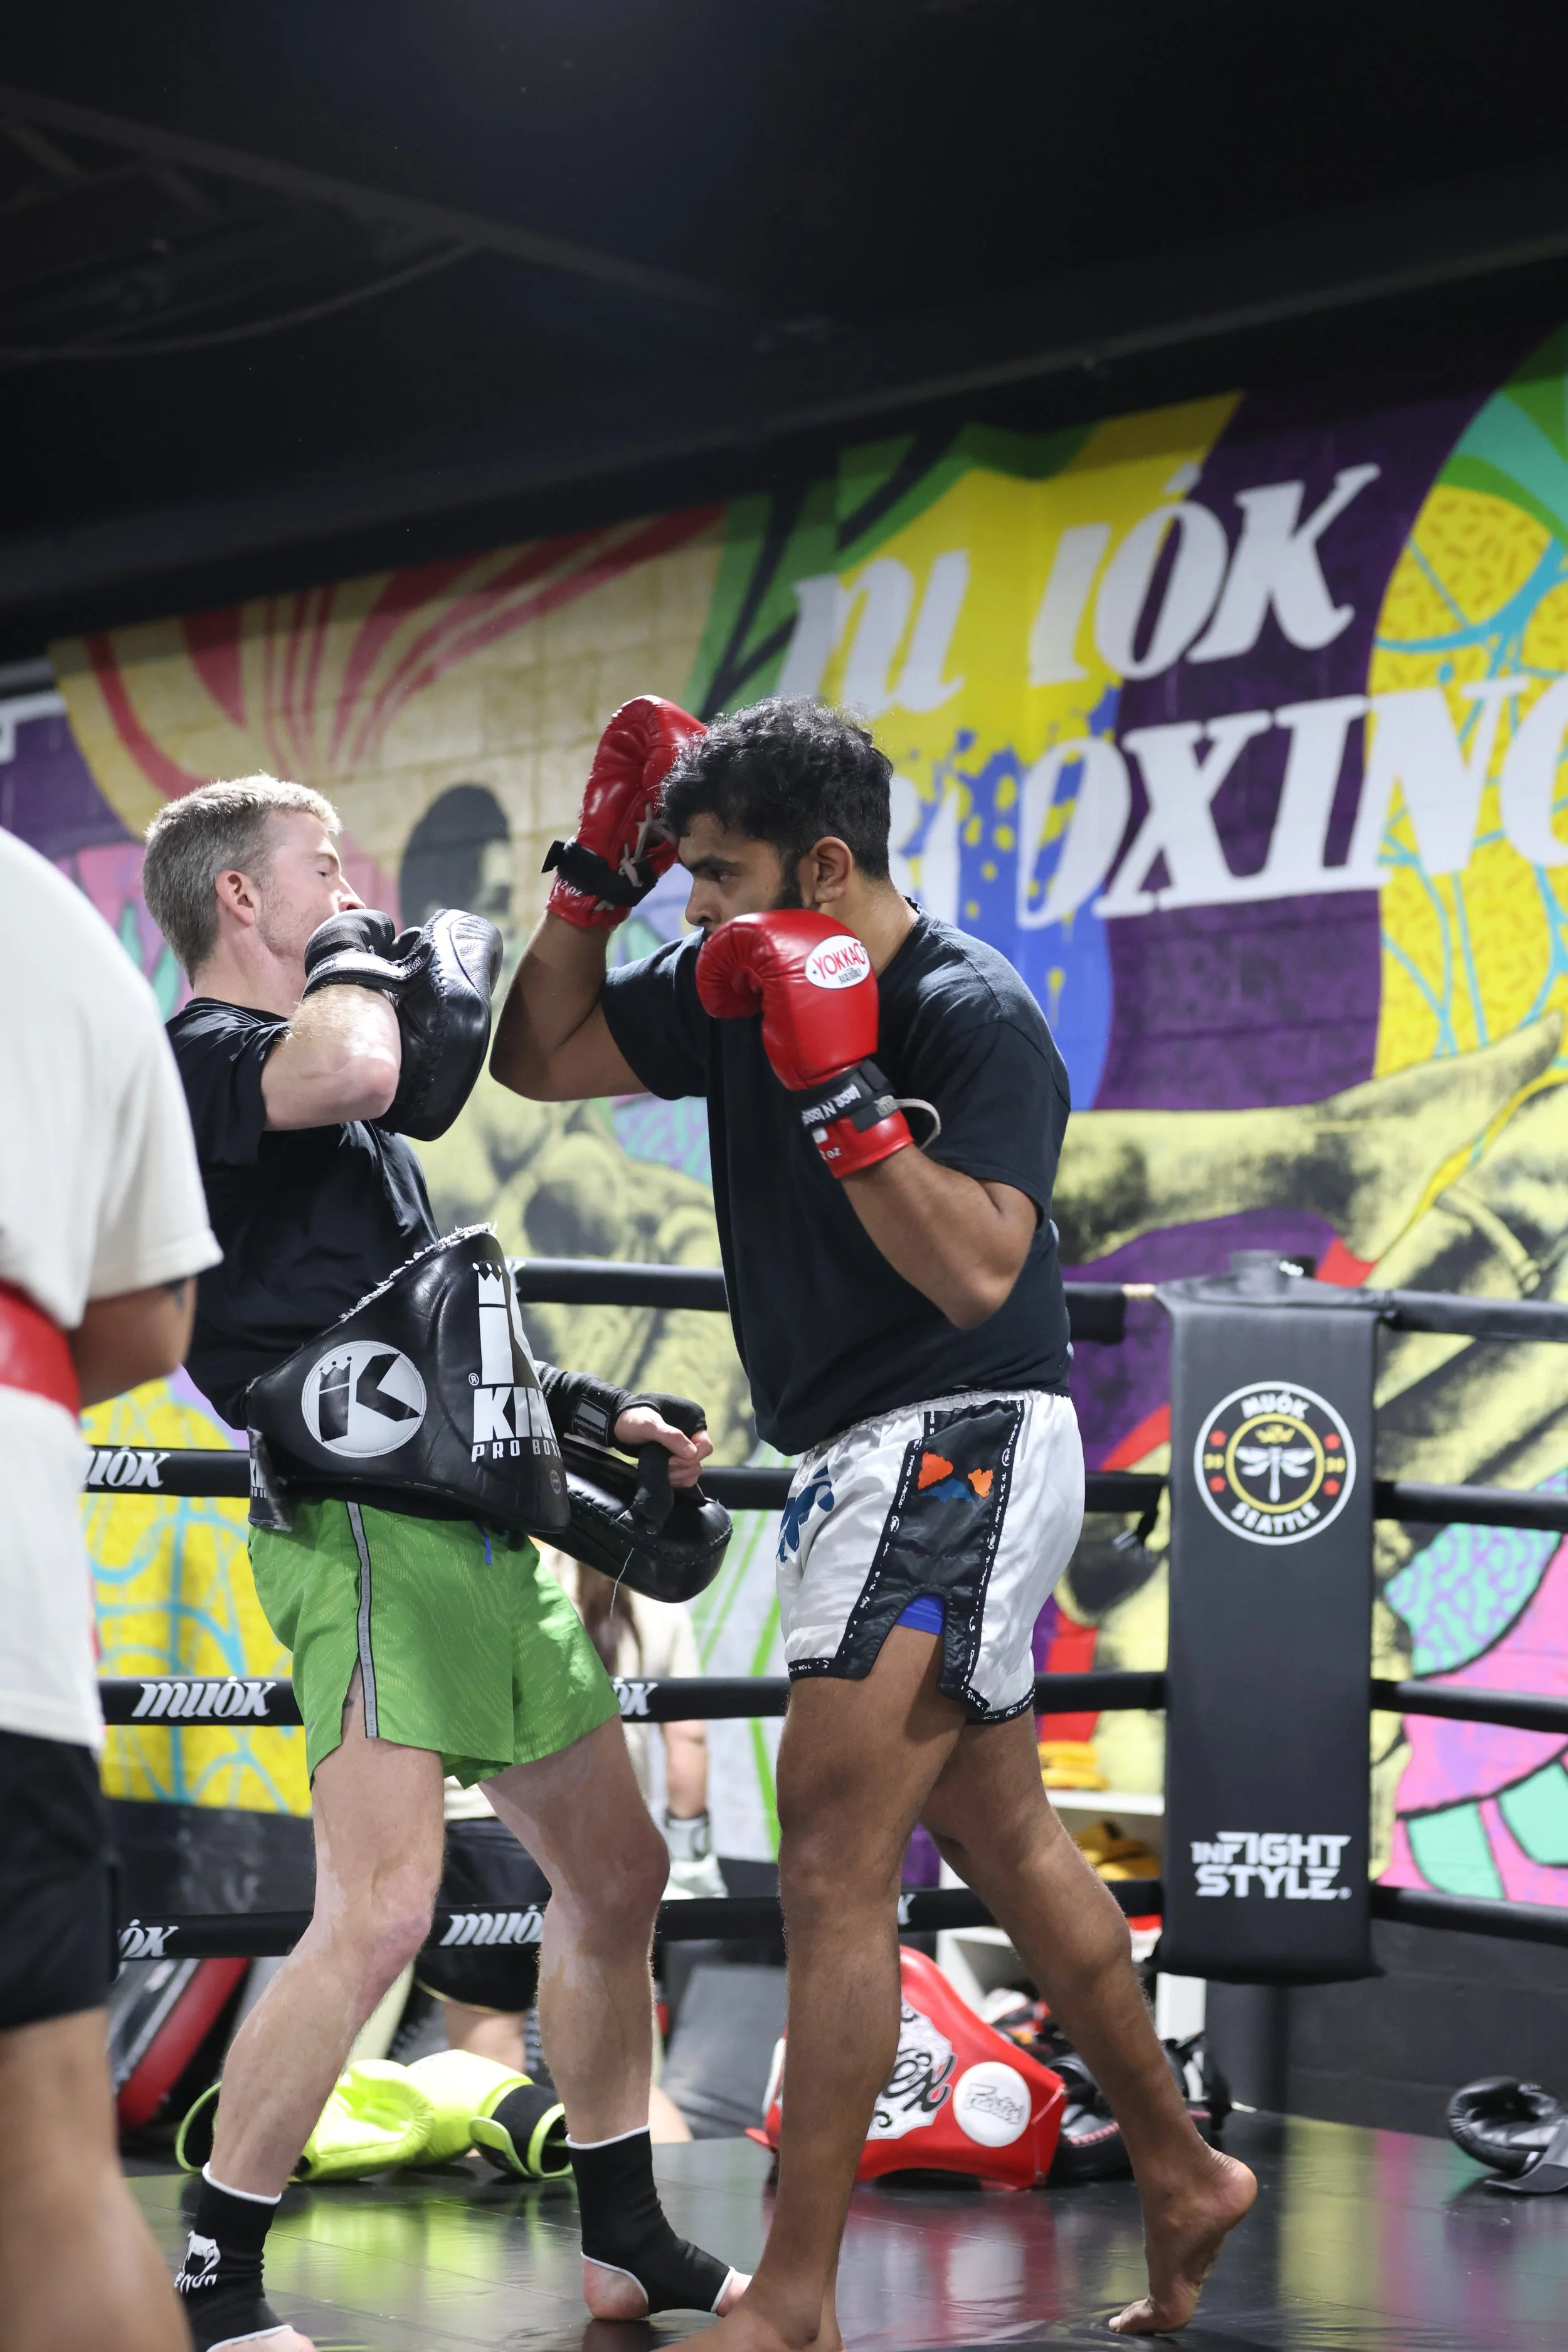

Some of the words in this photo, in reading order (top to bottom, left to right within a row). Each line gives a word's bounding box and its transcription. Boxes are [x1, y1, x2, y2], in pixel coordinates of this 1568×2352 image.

[812, 942, 866, 980] YOKKAO
[473, 1386, 558, 1444] KIN
[471, 1440, 521, 1463] PRO
[1231, 1501, 1321, 1534] SEATTLE
[1194, 1863, 1341, 1901] STYLE
[439, 1904, 544, 1946] muó
[174, 2271, 218, 2293] ENUM
